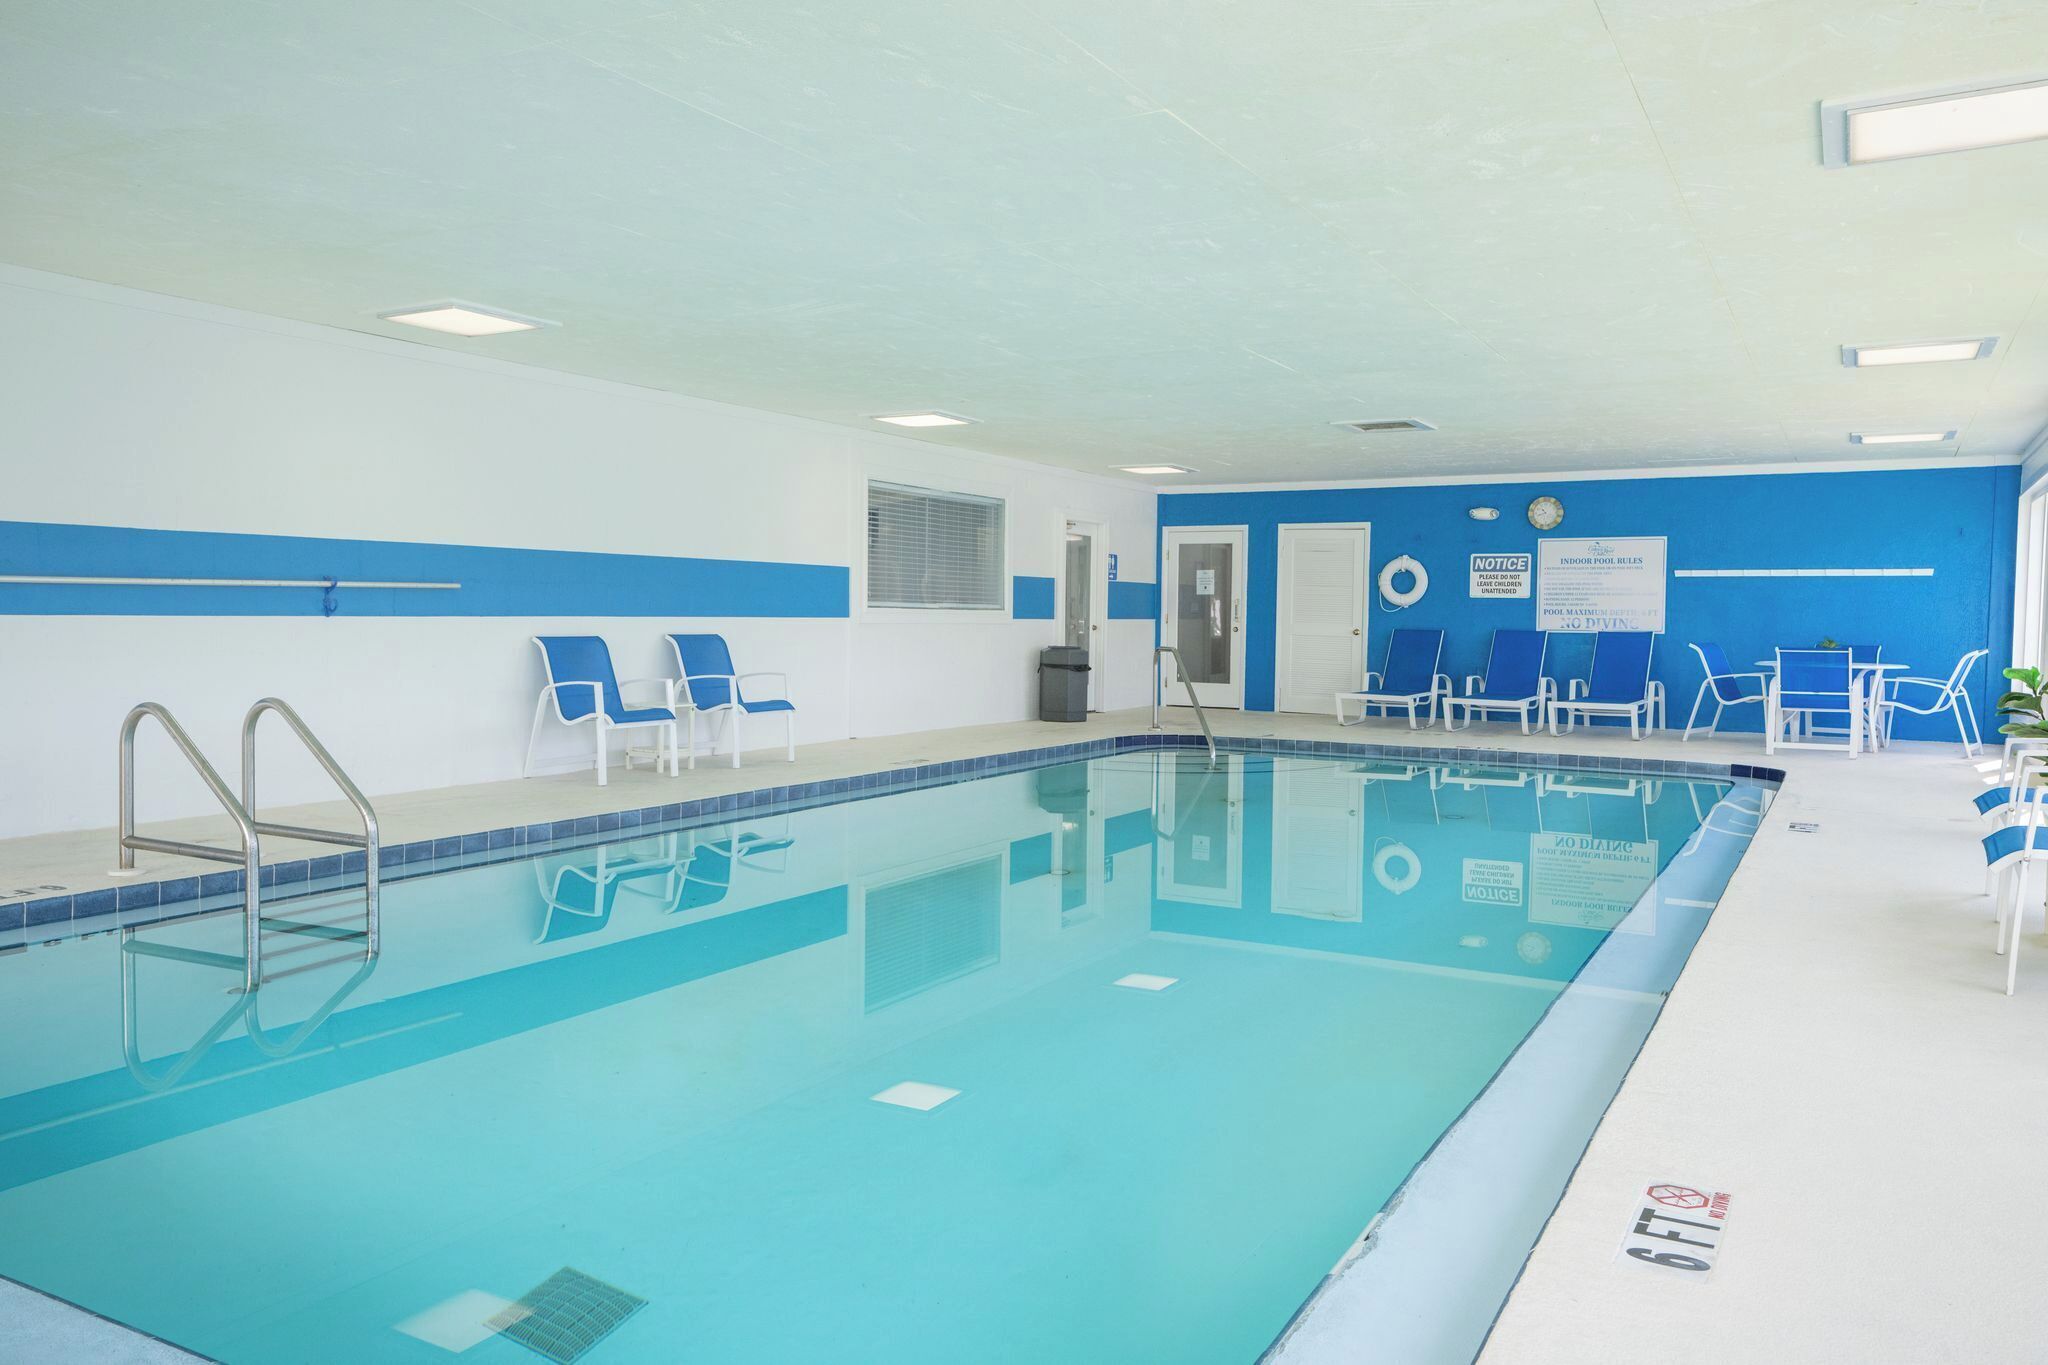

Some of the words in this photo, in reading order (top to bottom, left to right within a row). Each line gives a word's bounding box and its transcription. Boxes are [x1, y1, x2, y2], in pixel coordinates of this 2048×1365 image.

[1474, 557, 1527, 570] NOTICE
[1616, 557, 1643, 565] RULES
[1560, 617, 1581, 629] NO
[1711, 1191, 1731, 1211] DIVING
[1708, 1210, 1726, 1220] NO
[1633, 1207, 1721, 1249] FT
[1626, 1247, 1711, 1271] 6
